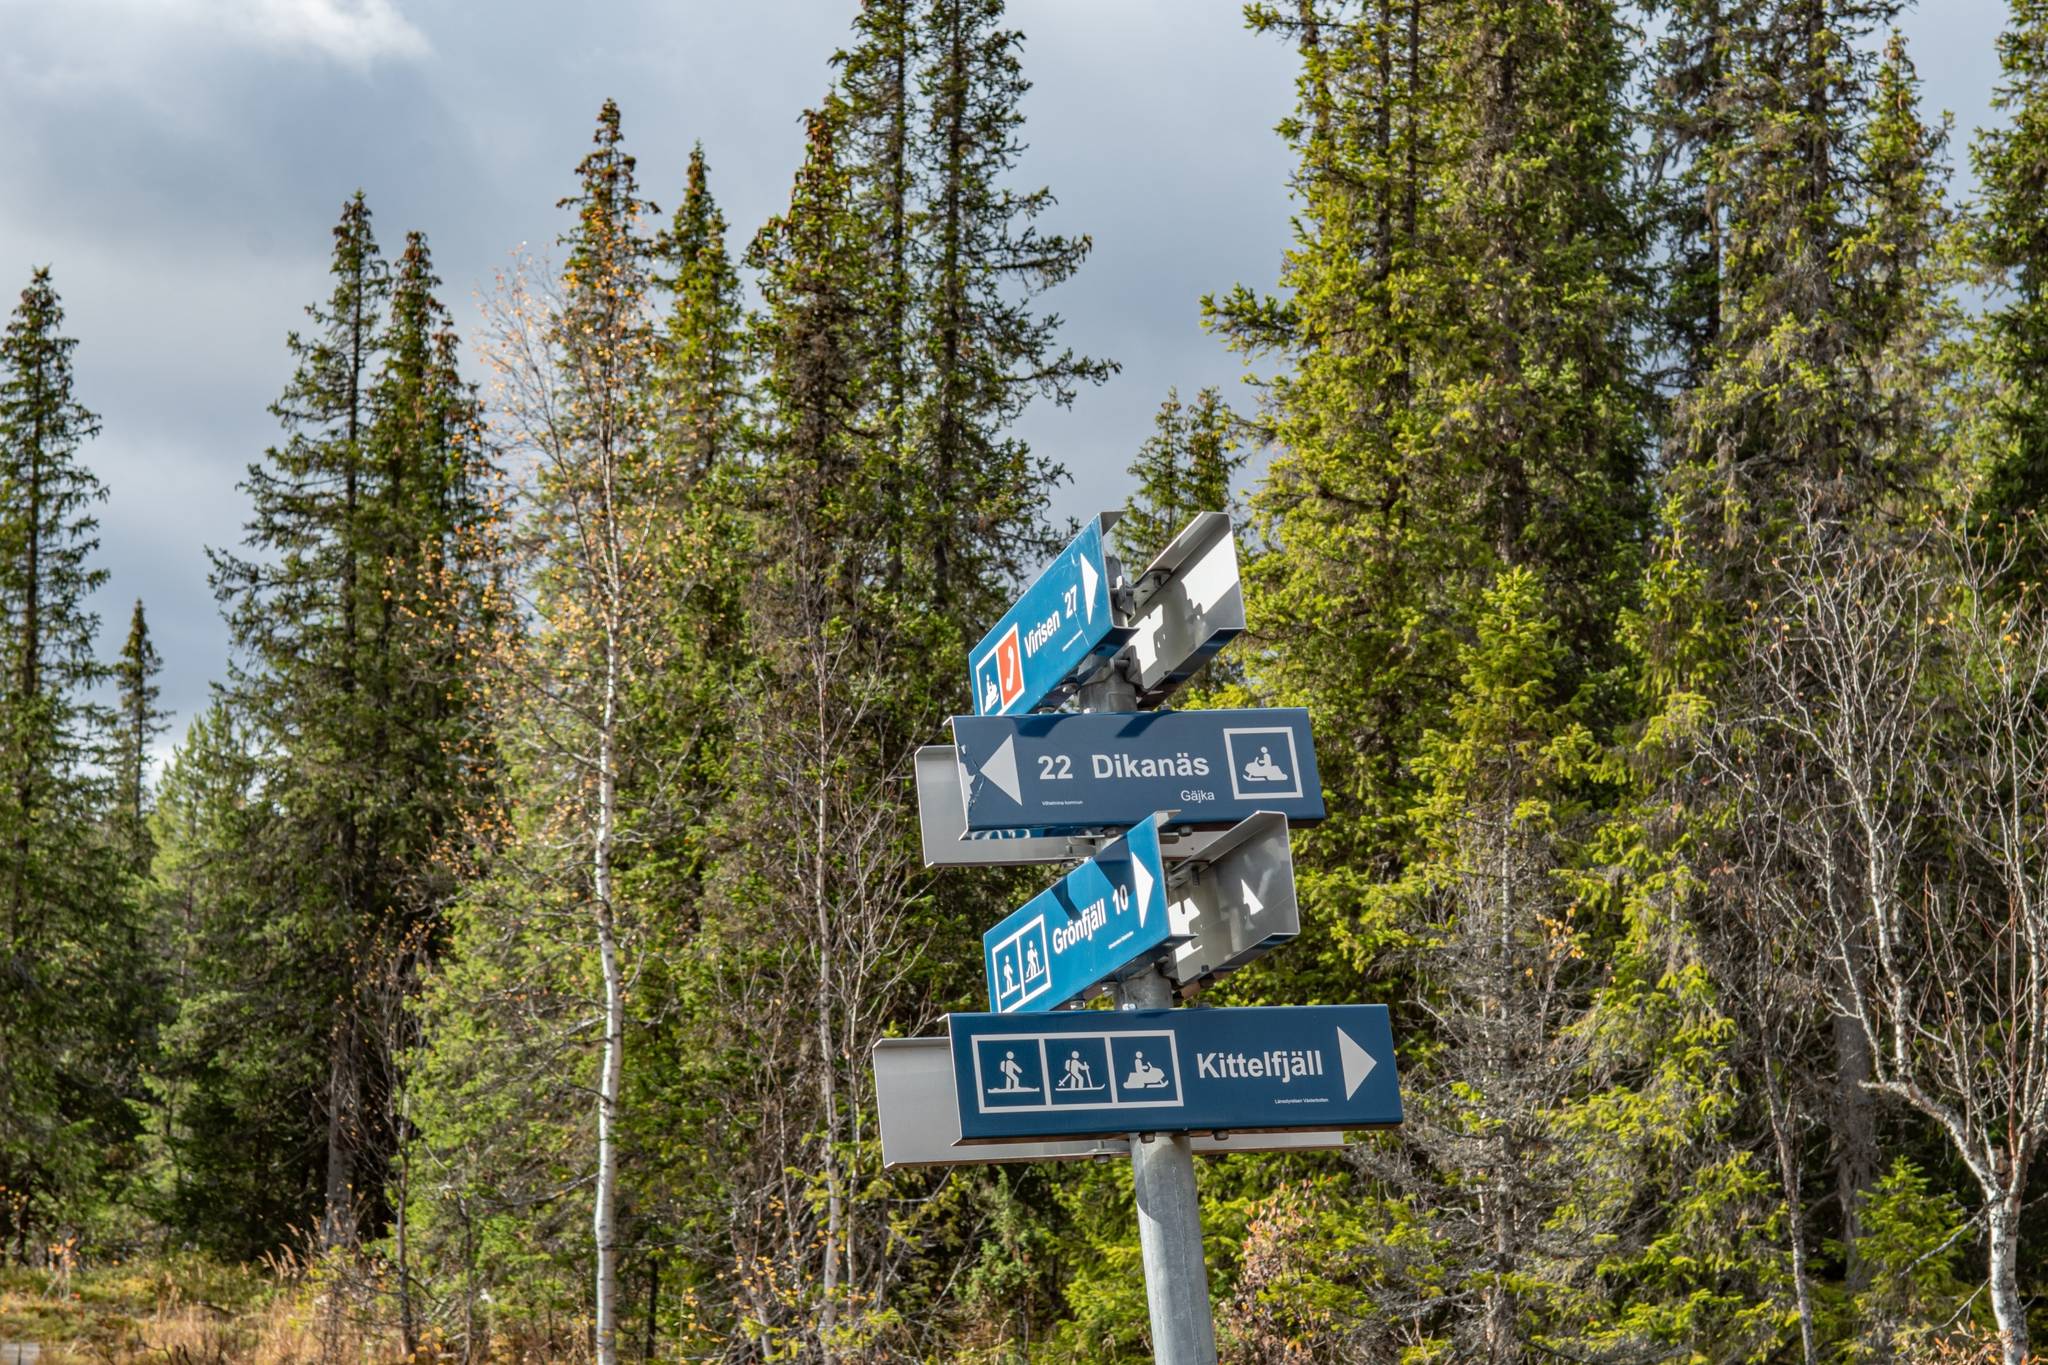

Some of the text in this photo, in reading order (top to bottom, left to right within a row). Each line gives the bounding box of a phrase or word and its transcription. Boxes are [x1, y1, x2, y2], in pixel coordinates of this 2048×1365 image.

[1024, 610, 1060, 658] Virisen
[1064, 584, 1077, 620] 27
[1037, 752, 1210, 780] 22 Dikanäs
[1180, 790, 1215, 803] Gäjka
[1052, 898, 1107, 954] Grönfjäll
[1112, 884, 1129, 915] 10
[1196, 1050, 1323, 1083] Kittelfjäll
